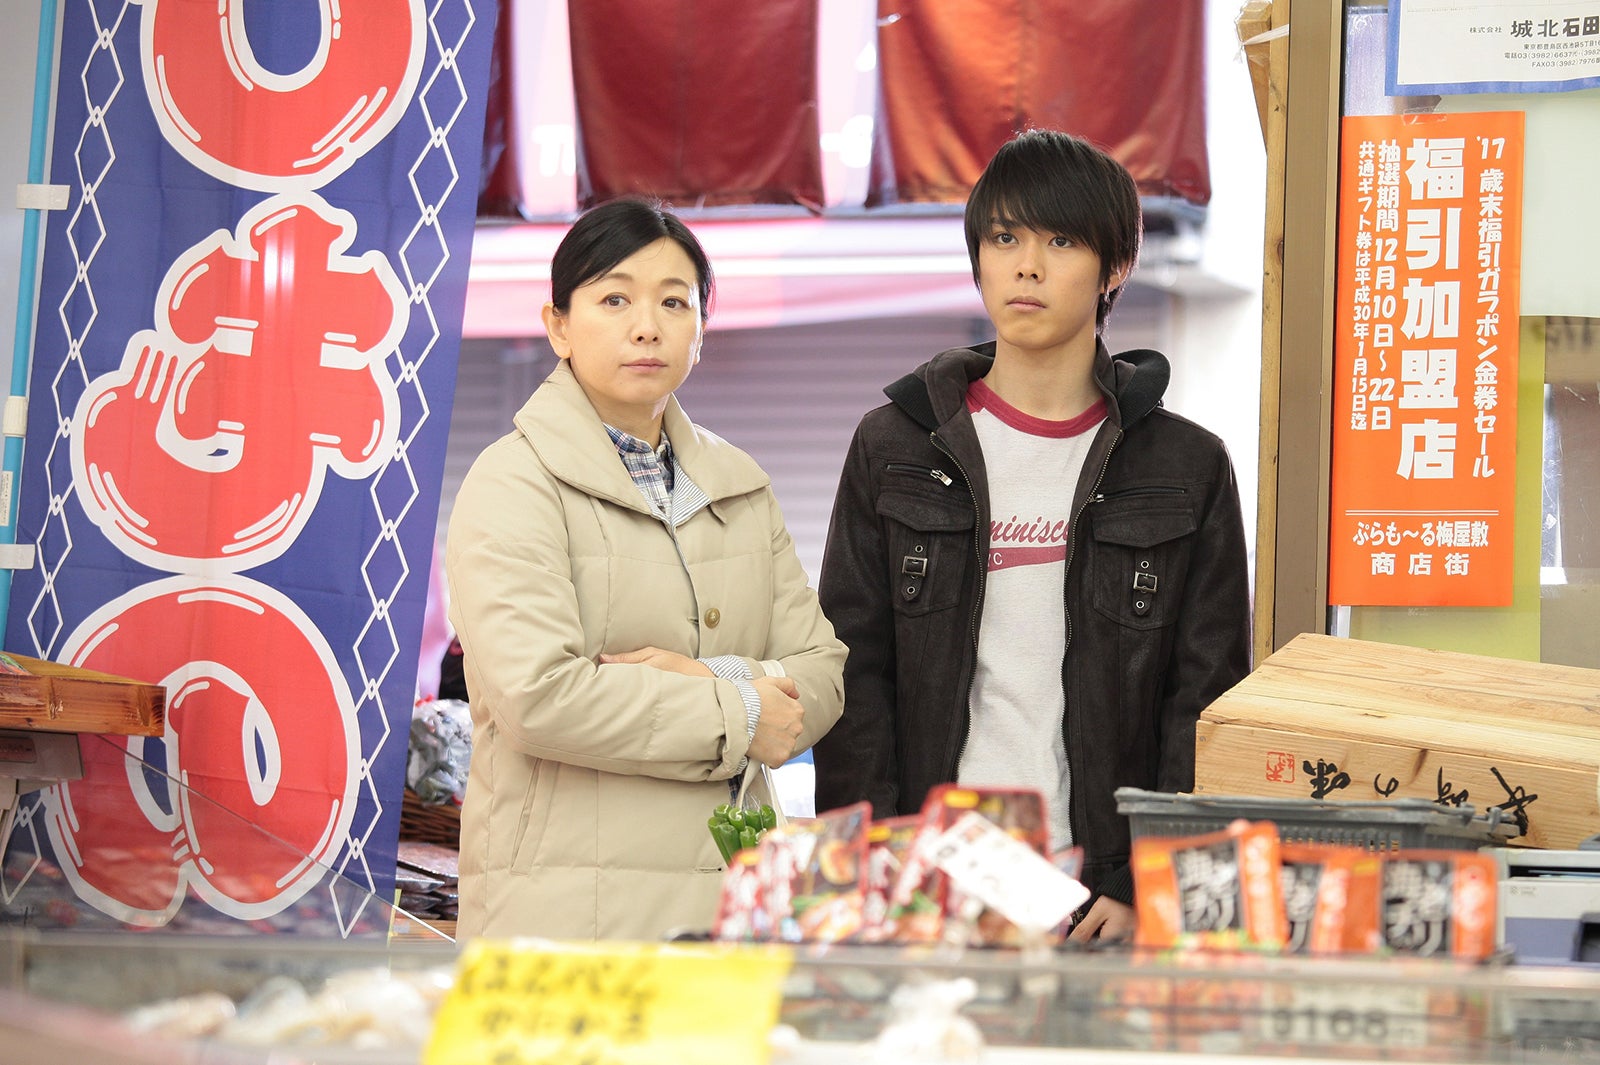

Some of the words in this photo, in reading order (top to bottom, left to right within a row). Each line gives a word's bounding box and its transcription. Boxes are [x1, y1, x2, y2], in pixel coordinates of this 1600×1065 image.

[1510, 16, 1600, 38] 城北石田
[1396, 137, 1465, 480] 福引加盟店
[1352, 520, 1489, 548] ぷらも〜る梅屋敷
